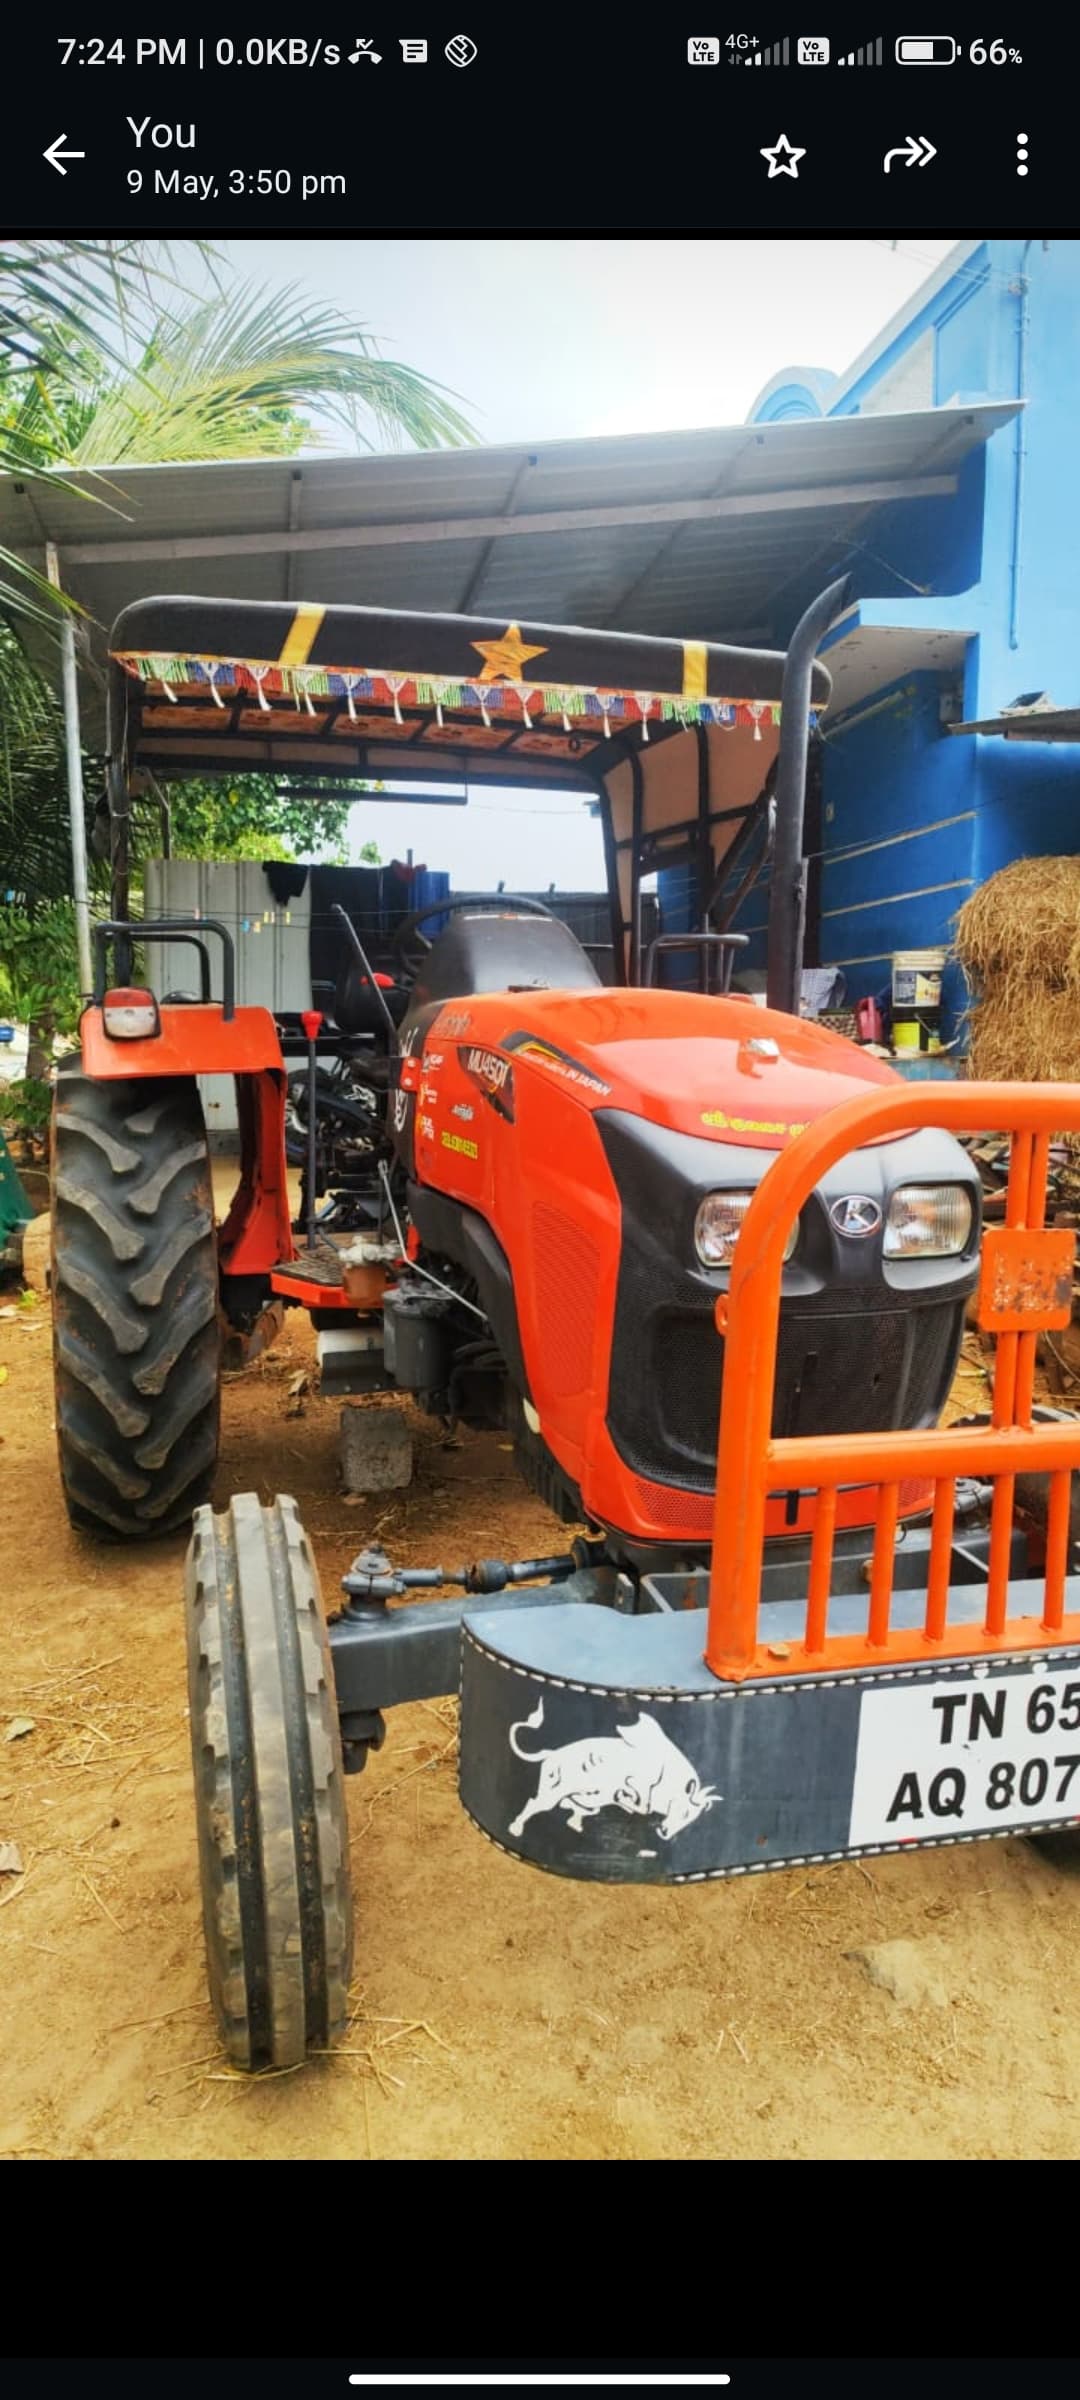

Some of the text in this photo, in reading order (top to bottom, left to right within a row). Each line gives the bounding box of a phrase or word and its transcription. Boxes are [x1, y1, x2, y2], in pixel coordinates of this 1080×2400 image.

[932, 1682, 1080, 1744] TN 65
[886, 1754, 1080, 1822] AQ 807
